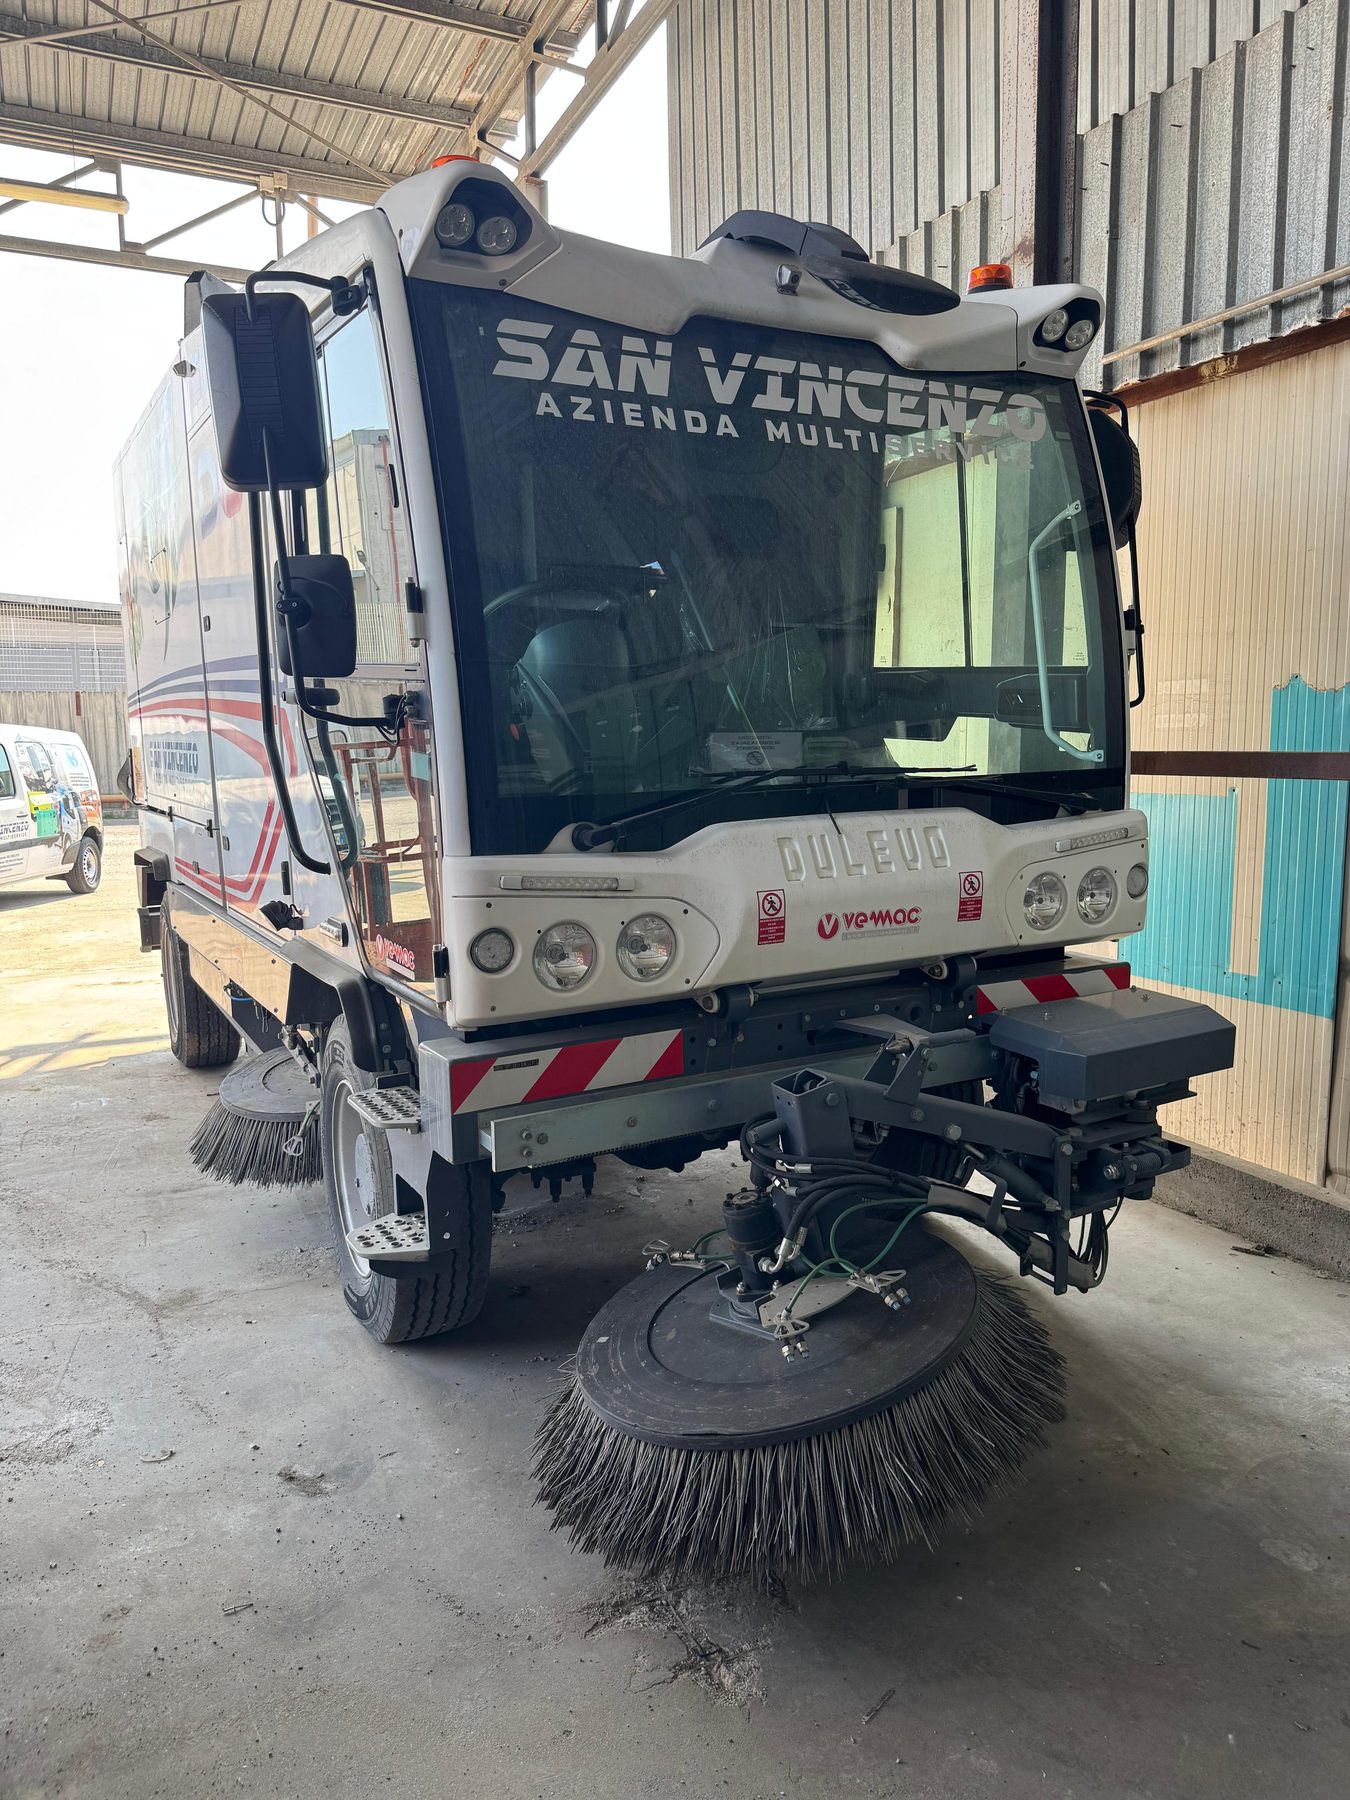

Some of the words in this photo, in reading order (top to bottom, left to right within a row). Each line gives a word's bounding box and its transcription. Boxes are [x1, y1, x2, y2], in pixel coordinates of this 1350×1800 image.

[492, 318, 673, 397] SAN
[698, 346, 1047, 442] VINCENZO
[535, 392, 740, 438] AZIENDA
[777, 826, 951, 882] DULEVO
